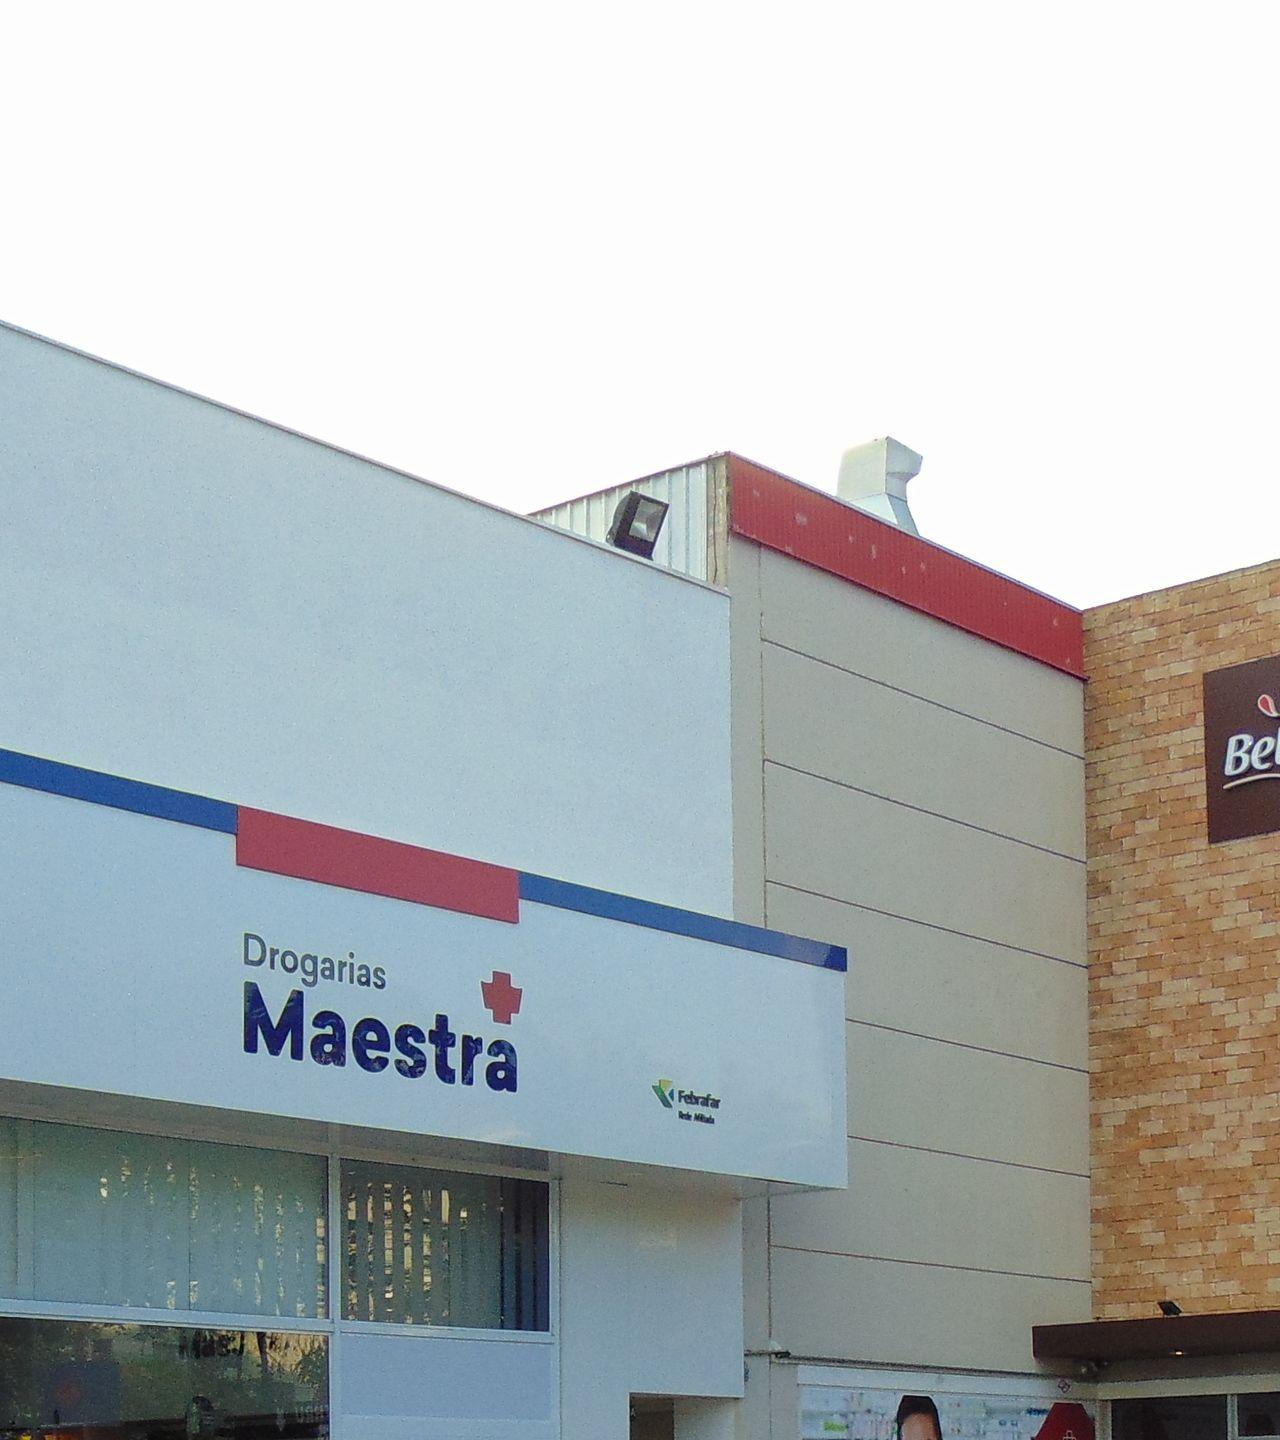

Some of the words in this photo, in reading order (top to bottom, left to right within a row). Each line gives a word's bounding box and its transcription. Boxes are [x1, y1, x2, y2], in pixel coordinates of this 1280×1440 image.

[243, 932, 386, 989] Drogarias
[243, 981, 518, 1093] Maestra
[678, 1090, 721, 1109] Febrafar
